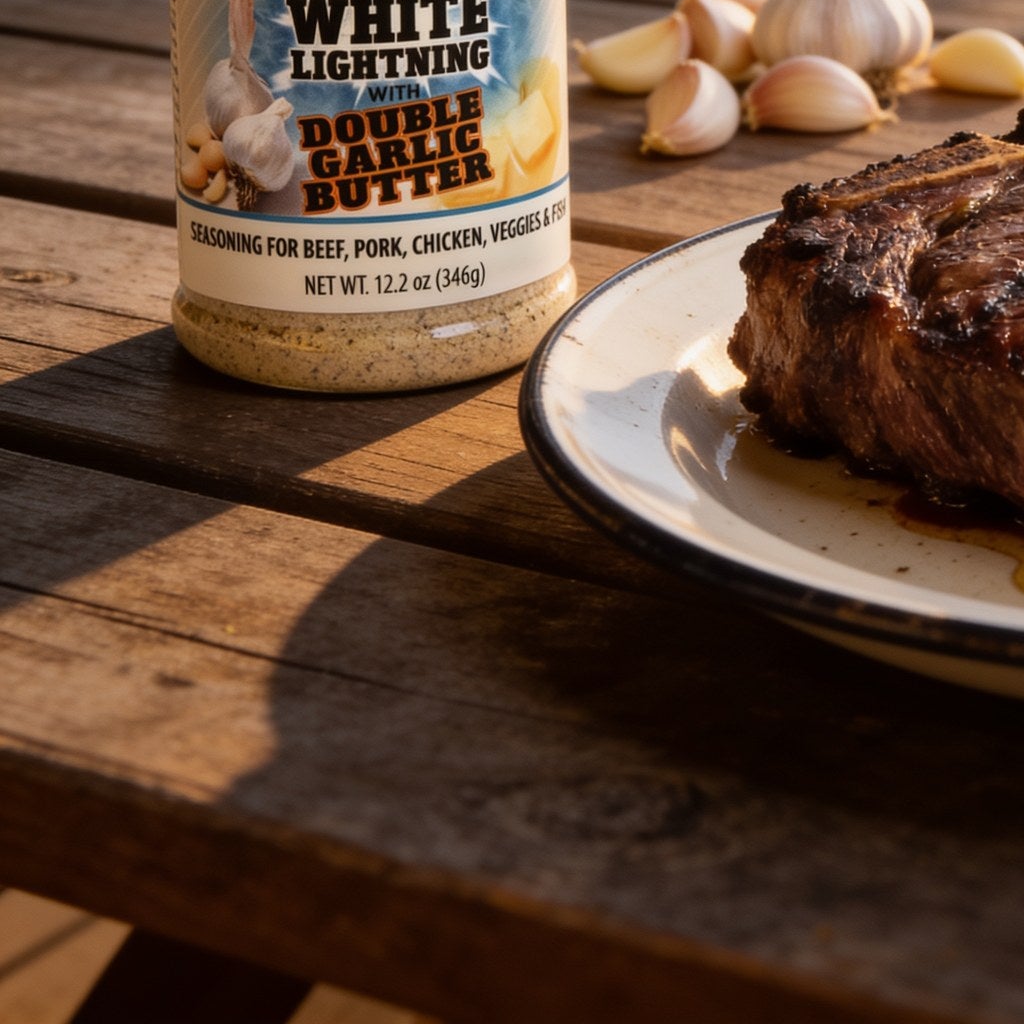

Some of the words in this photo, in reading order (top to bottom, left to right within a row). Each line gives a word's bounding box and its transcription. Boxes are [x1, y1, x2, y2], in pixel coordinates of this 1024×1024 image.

[291, 39, 490, 81] LIGHTNING
[297, 87, 484, 149] DOUBLE
[368, 84, 420, 102] WITH
[309, 122, 481, 179] GARLIC
[301, 154, 495, 214] BUTTER
[190, 220, 263, 256] SEASONING
[267, 236, 298, 259] FOR
[303, 240, 350, 261] BEEF,
[355, 234, 407, 259] PORK,
[413, 225, 488, 254] CHICKEN,
[490, 210, 542, 243] VEGGIES
[543, 207, 550, 227] &
[304, 274, 336, 296] NET
[340, 274, 369, 295] WT.
[375, 273, 407, 294] 12.2
[414, 274, 431, 290] oz
[436, 261, 486, 294] (346g)
